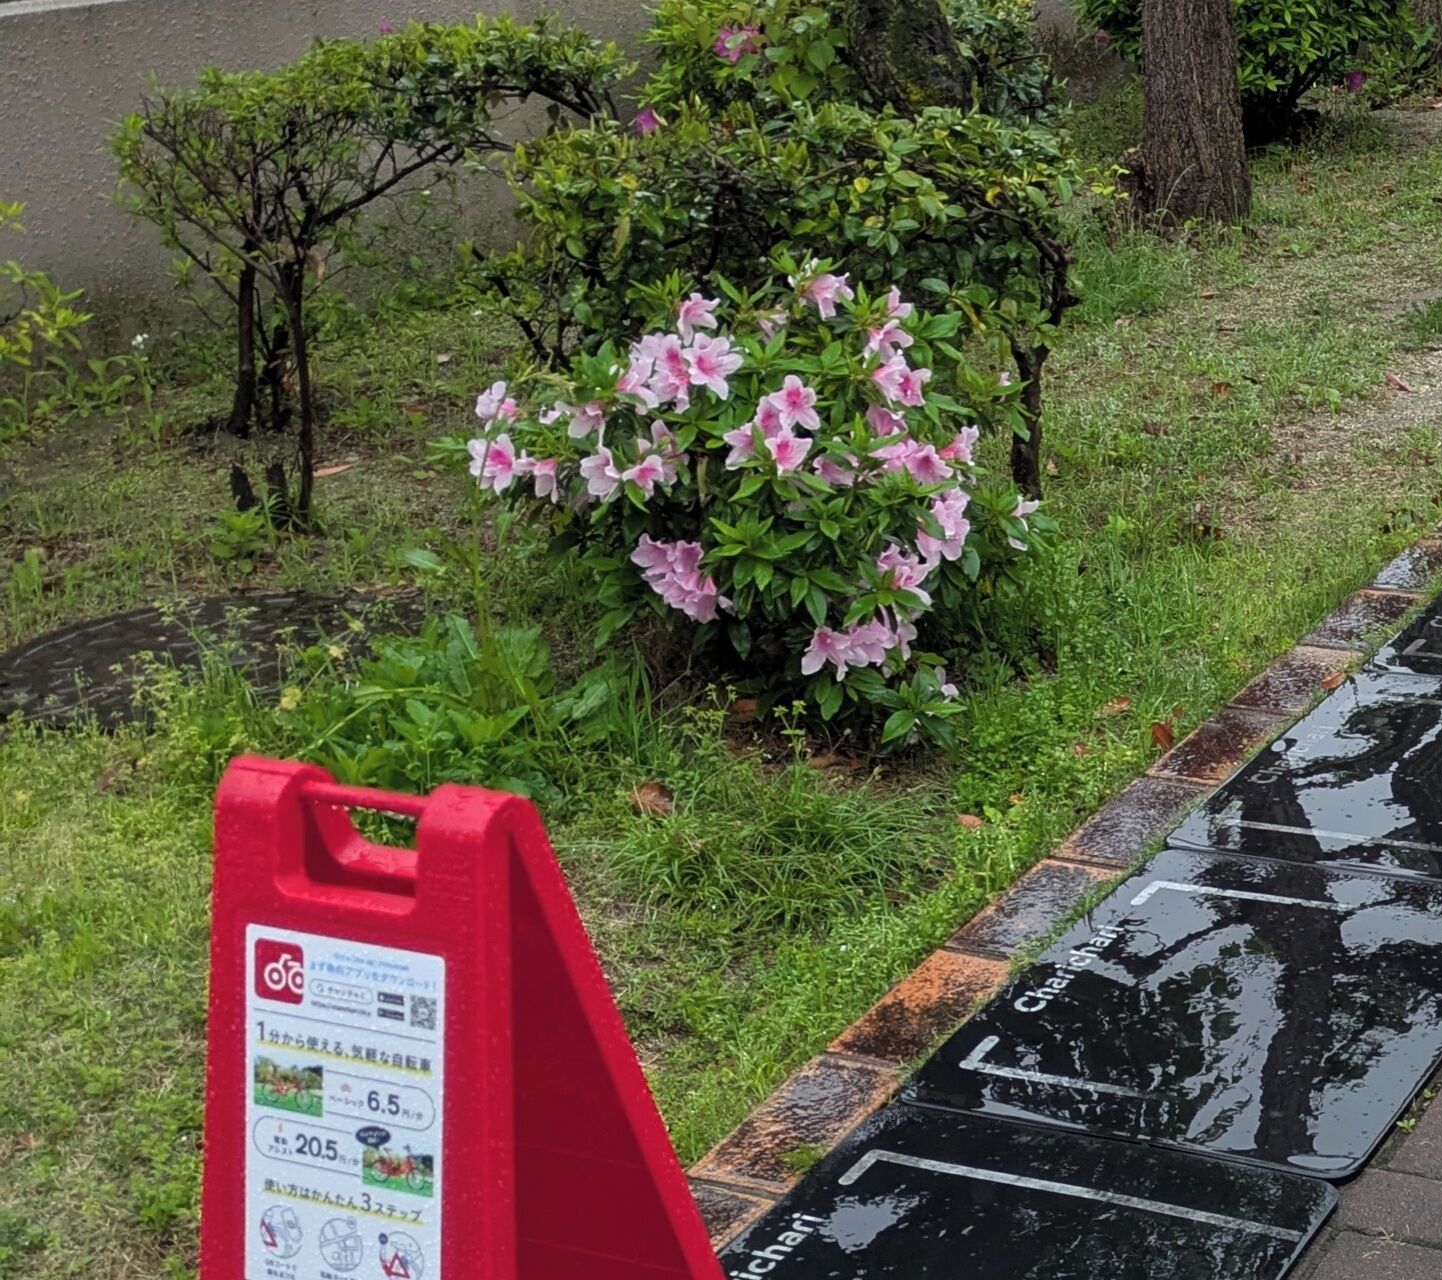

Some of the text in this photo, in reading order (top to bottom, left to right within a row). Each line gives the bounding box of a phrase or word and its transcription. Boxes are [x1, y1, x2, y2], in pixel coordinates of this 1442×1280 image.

[1013, 924, 1126, 1013] Charichari
[256, 1021, 432, 1073] 1分から使える、気軽な自転車
[367, 1090, 401, 1116] 6.5
[295, 1133, 339, 1162] 20.5
[263, 1177, 423, 1221] 使い方はかんたん3ステップ
